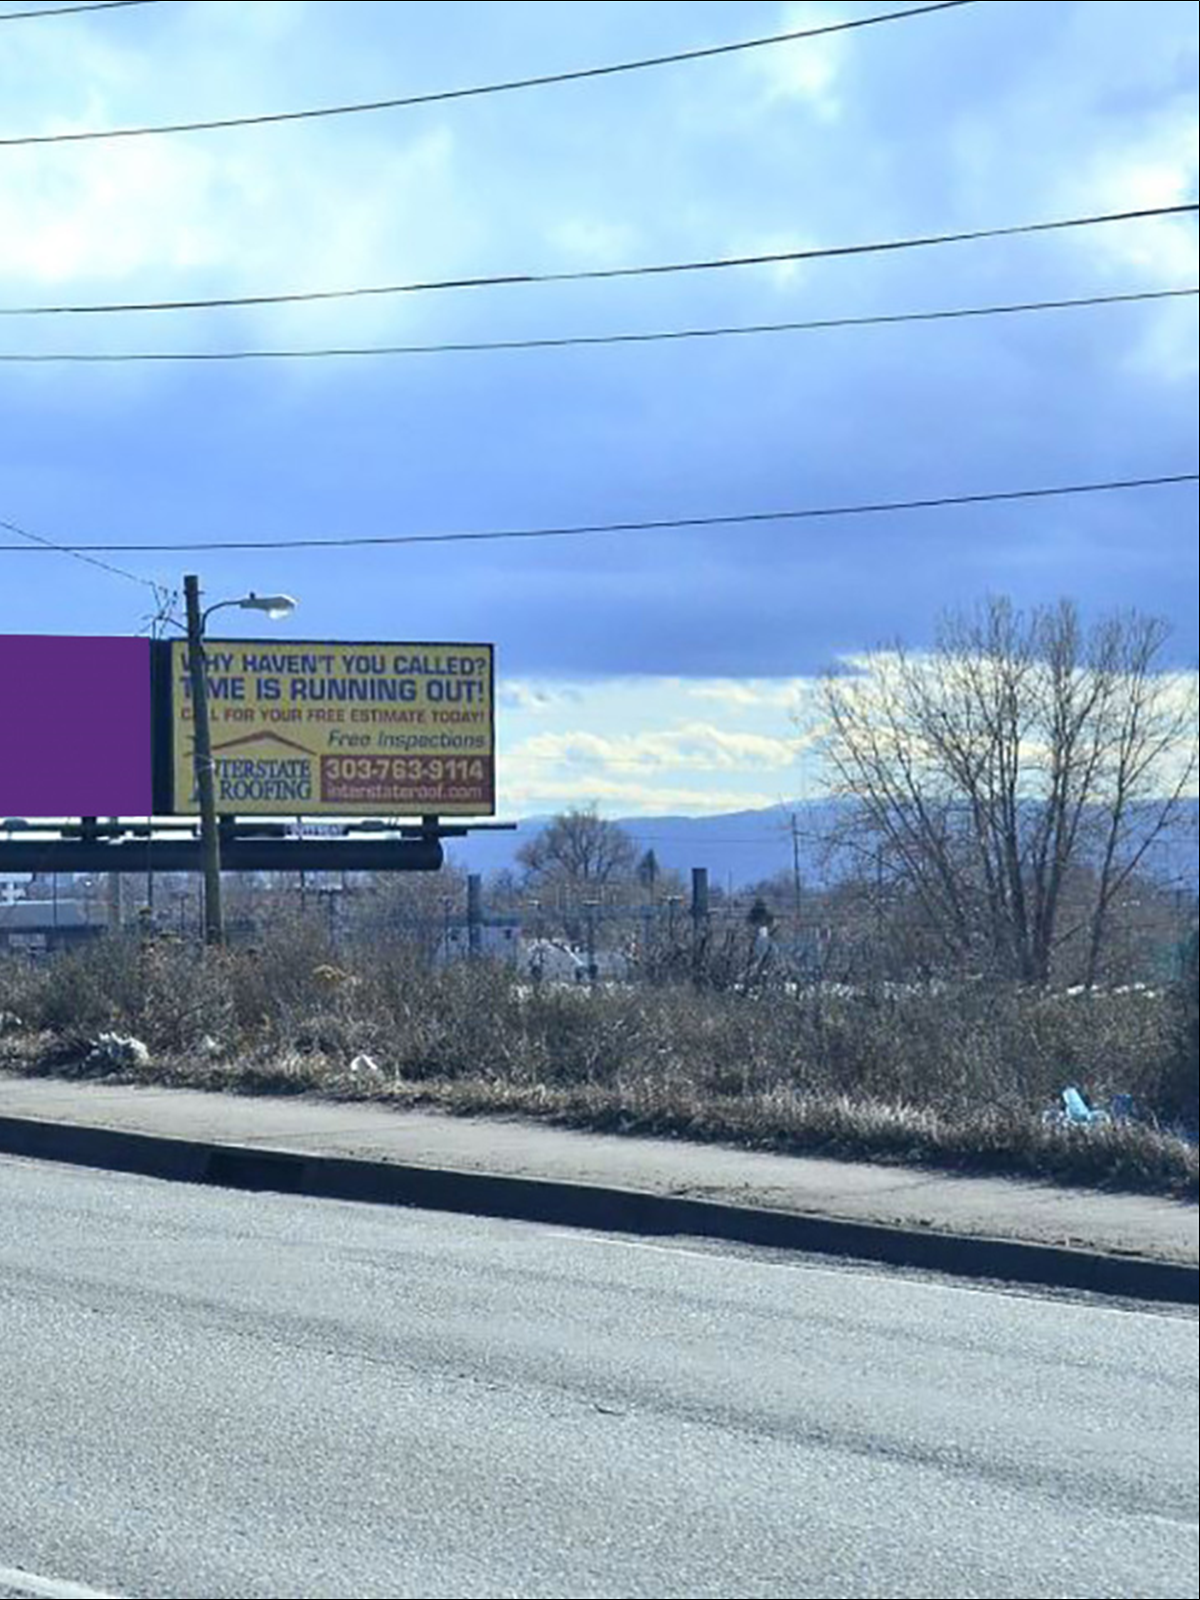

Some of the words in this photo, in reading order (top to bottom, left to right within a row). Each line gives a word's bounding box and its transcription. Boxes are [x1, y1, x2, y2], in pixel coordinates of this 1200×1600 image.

[243, 654, 335, 674] HAVEN'T
[343, 655, 386, 674] YOU
[393, 656, 486, 676] CALLED?
[180, 677, 245, 699] TME
[257, 678, 281, 700] IS
[291, 678, 417, 701] RUNNING
[427, 679, 484, 702] OUT!
[181, 708, 219, 721] CL
[225, 709, 255, 721] FOR
[262, 709, 302, 722] YOUR
[307, 710, 345, 722] FREE
[351, 710, 425, 723] ESTIMATE
[432, 711, 484, 724] TODAY!
[328, 730, 371, 747] Free
[377, 731, 486, 751] Inspections
[325, 758, 484, 781] 303-763-9114
[219, 780, 312, 801] ROOFING
[326, 783, 482, 799] interstateroof.com
